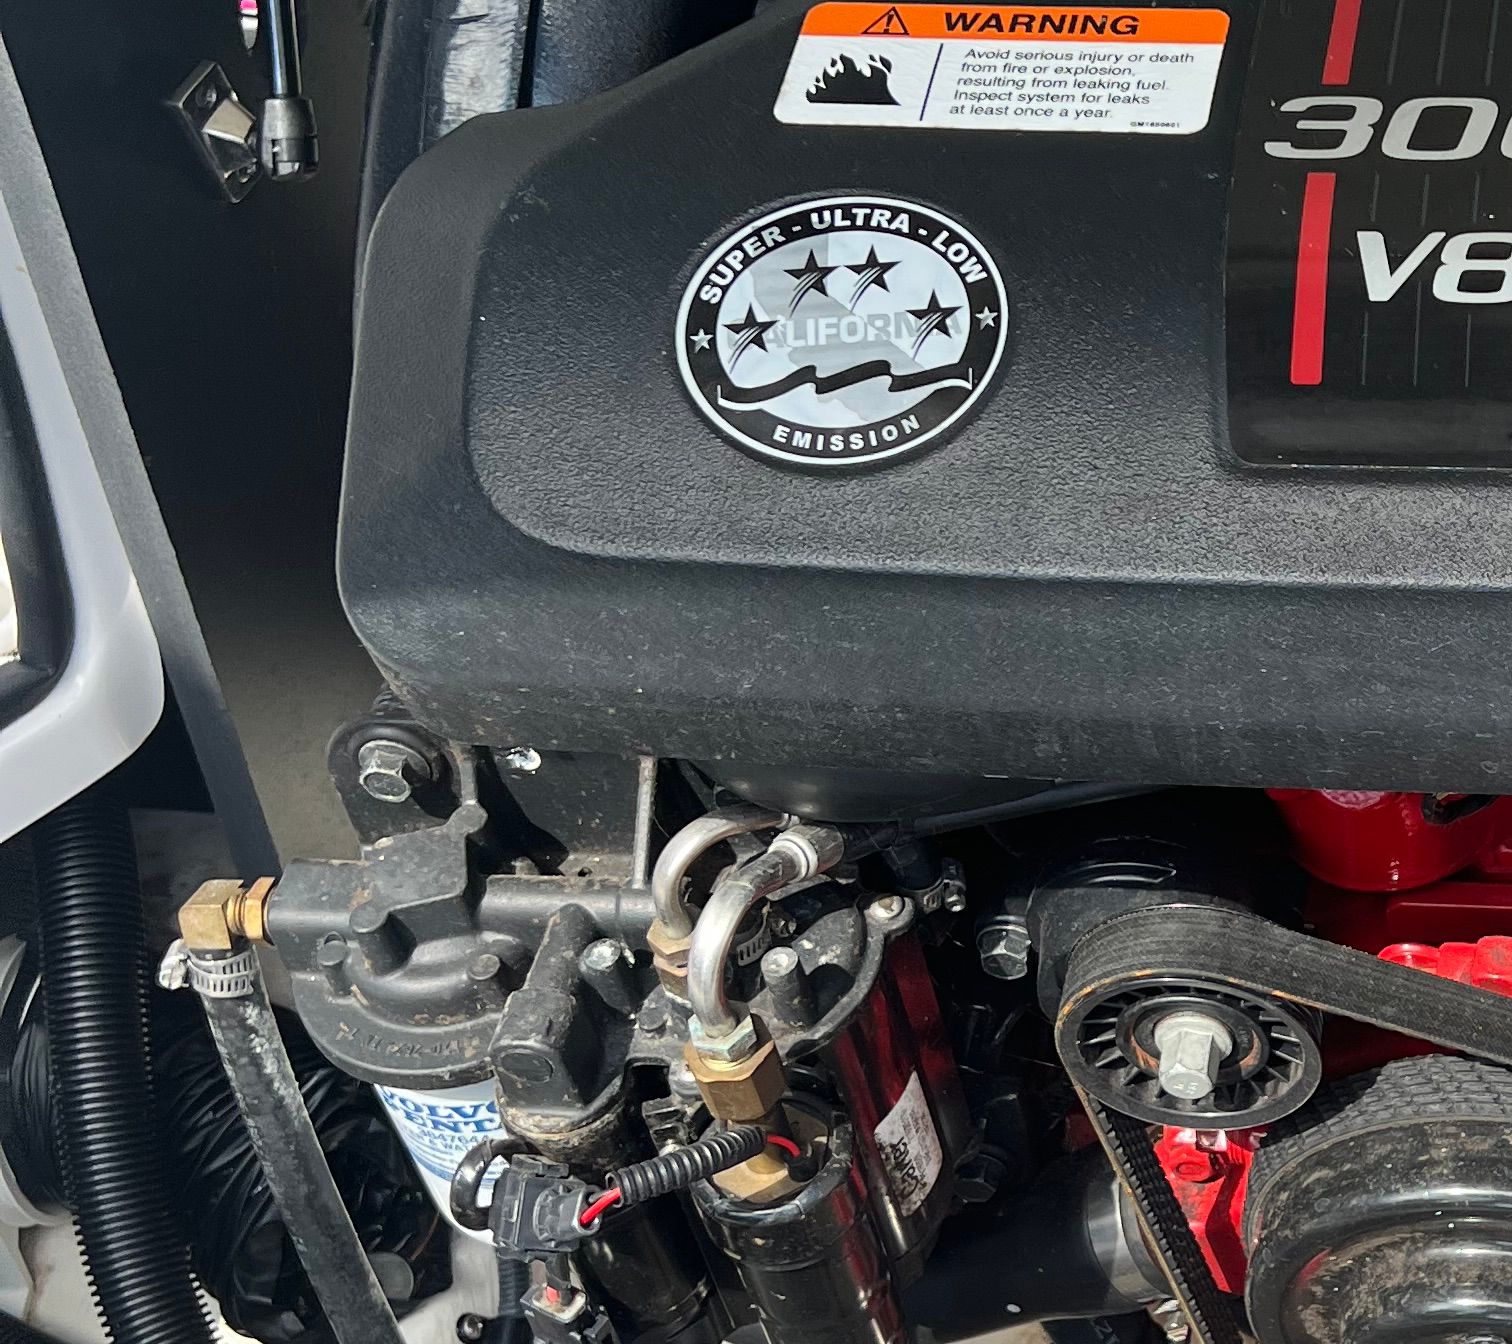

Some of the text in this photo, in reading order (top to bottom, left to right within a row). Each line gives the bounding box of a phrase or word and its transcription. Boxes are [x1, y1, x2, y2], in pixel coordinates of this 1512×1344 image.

[945, 12, 1141, 35] WARNING
[965, 48, 1194, 64] Avoid serious injury or death
[961, 63, 997, 73] from
[1002, 62, 1027, 74] fire
[1033, 65, 1049, 74] or
[957, 77, 1025, 89] resulting
[1031, 77, 1067, 89] from
[1073, 78, 1130, 92] leaking
[954, 89, 1150, 105] Inspect system for leaks
[950, 105, 964, 114] at
[970, 105, 1009, 115] least
[1014, 108, 1054, 117] once
[1060, 109, 1068, 117] a
[699, 225, 786, 305] SUPER
[810, 207, 910, 233] ULTRA
[931, 230, 988, 285] LOW
[772, 414, 920, 452] EMISSION
